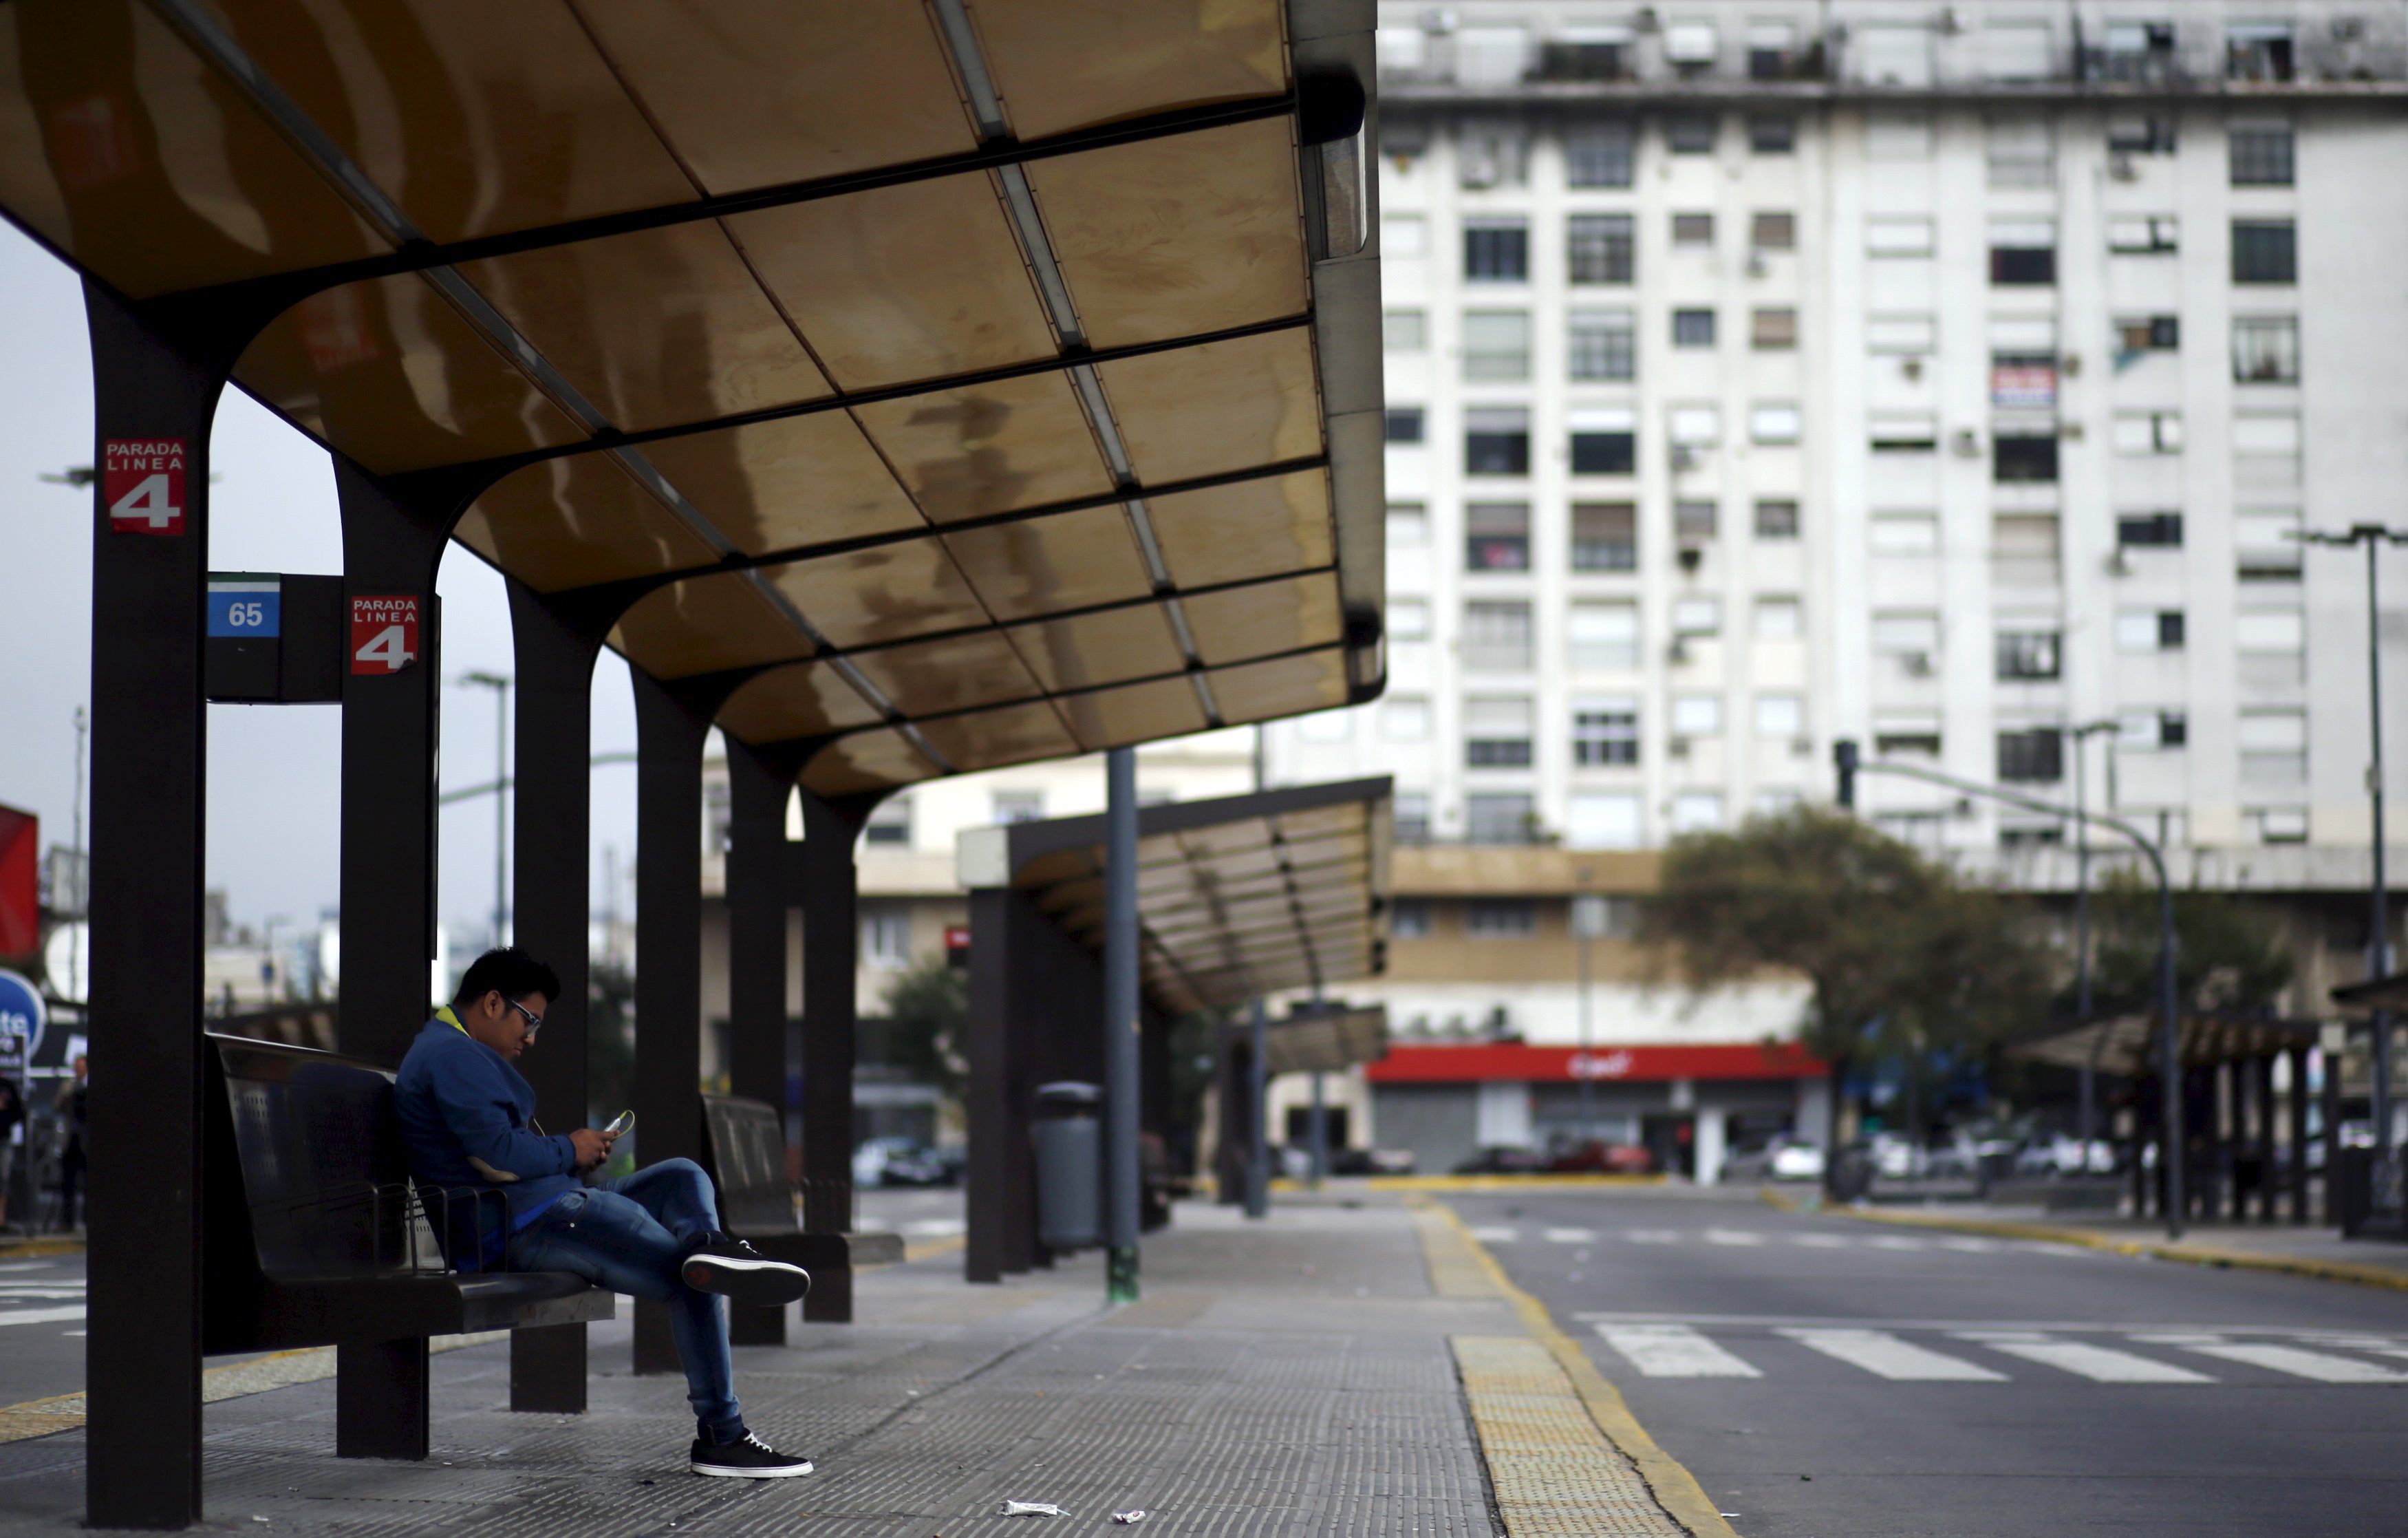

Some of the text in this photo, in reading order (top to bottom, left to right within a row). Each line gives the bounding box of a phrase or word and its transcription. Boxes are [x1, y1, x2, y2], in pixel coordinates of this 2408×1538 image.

[107, 443, 183, 456] PARADA
[107, 458, 182, 470] LINEA
[110, 474, 180, 527] 4
[354, 600, 416, 610] PARADA
[229, 602, 263, 627] 65
[354, 612, 416, 623] LINEA
[356, 625, 414, 670] 4
